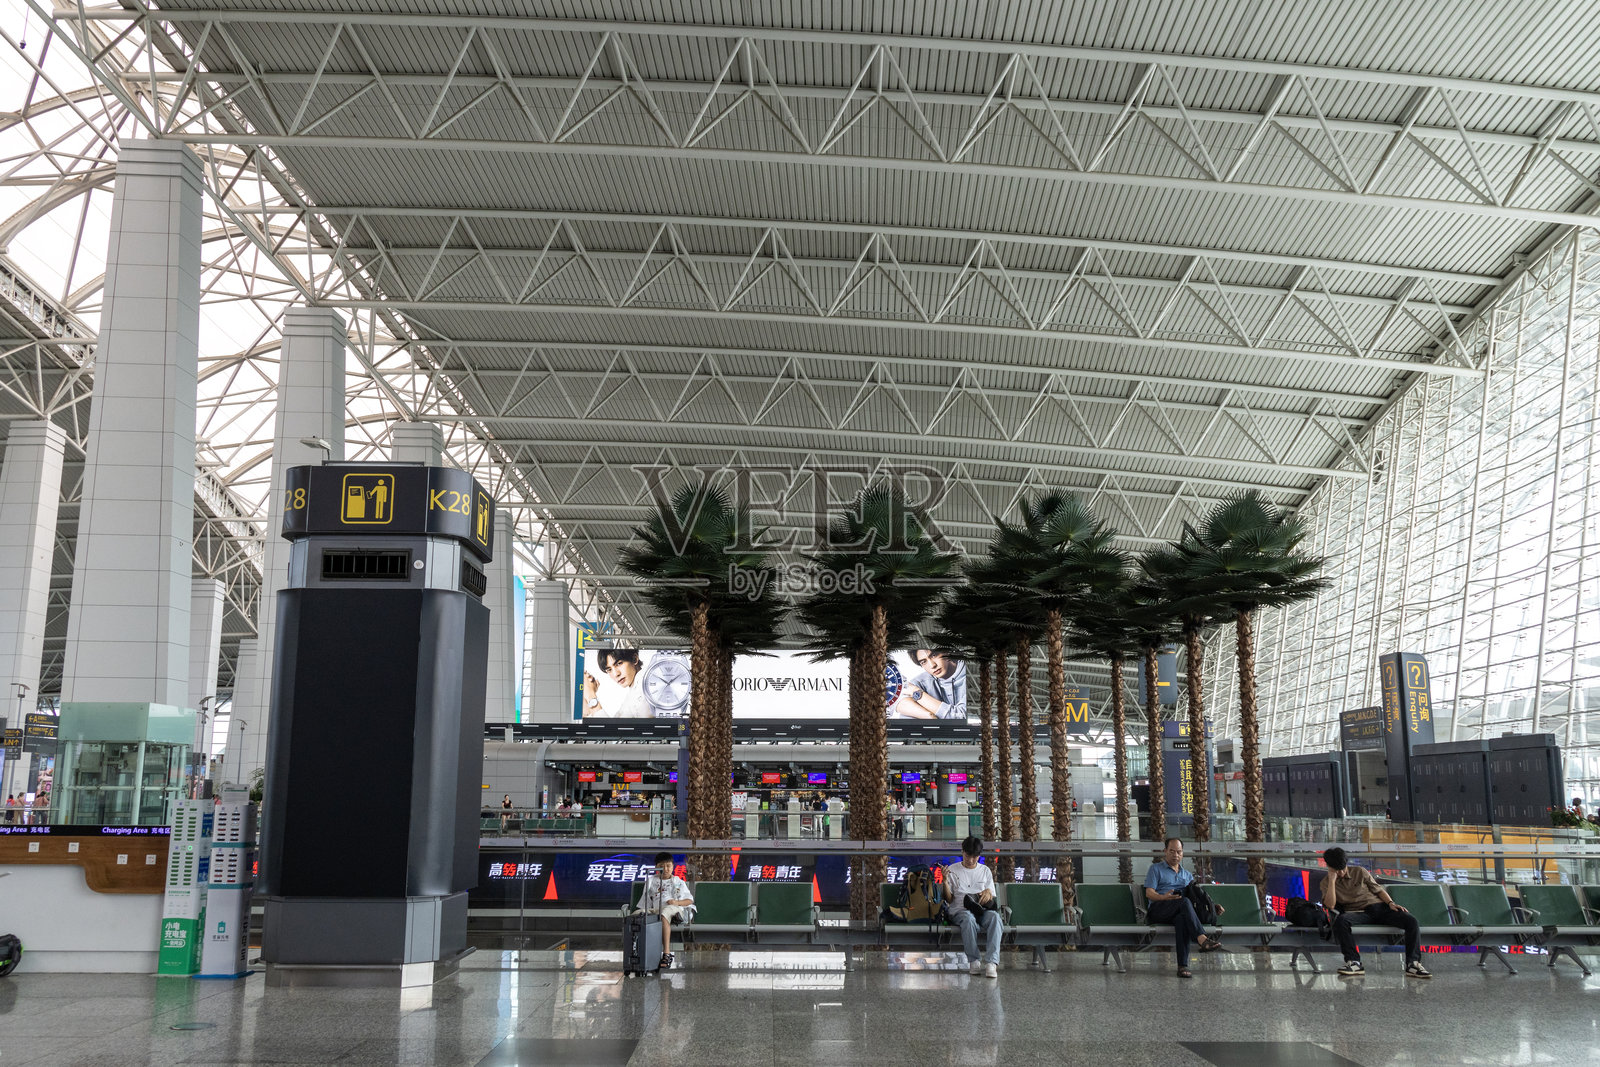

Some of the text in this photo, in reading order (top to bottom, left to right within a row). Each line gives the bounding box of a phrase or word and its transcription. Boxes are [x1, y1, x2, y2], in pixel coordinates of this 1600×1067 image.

[429, 489, 471, 516] K28
[788, 677, 843, 691] ARMANI
[1066, 702, 1088, 722] M
[1385, 692, 1393, 733] Enquiry
[1409, 691, 1419, 733] Enquiry
[102, 827, 132, 835] Charging
